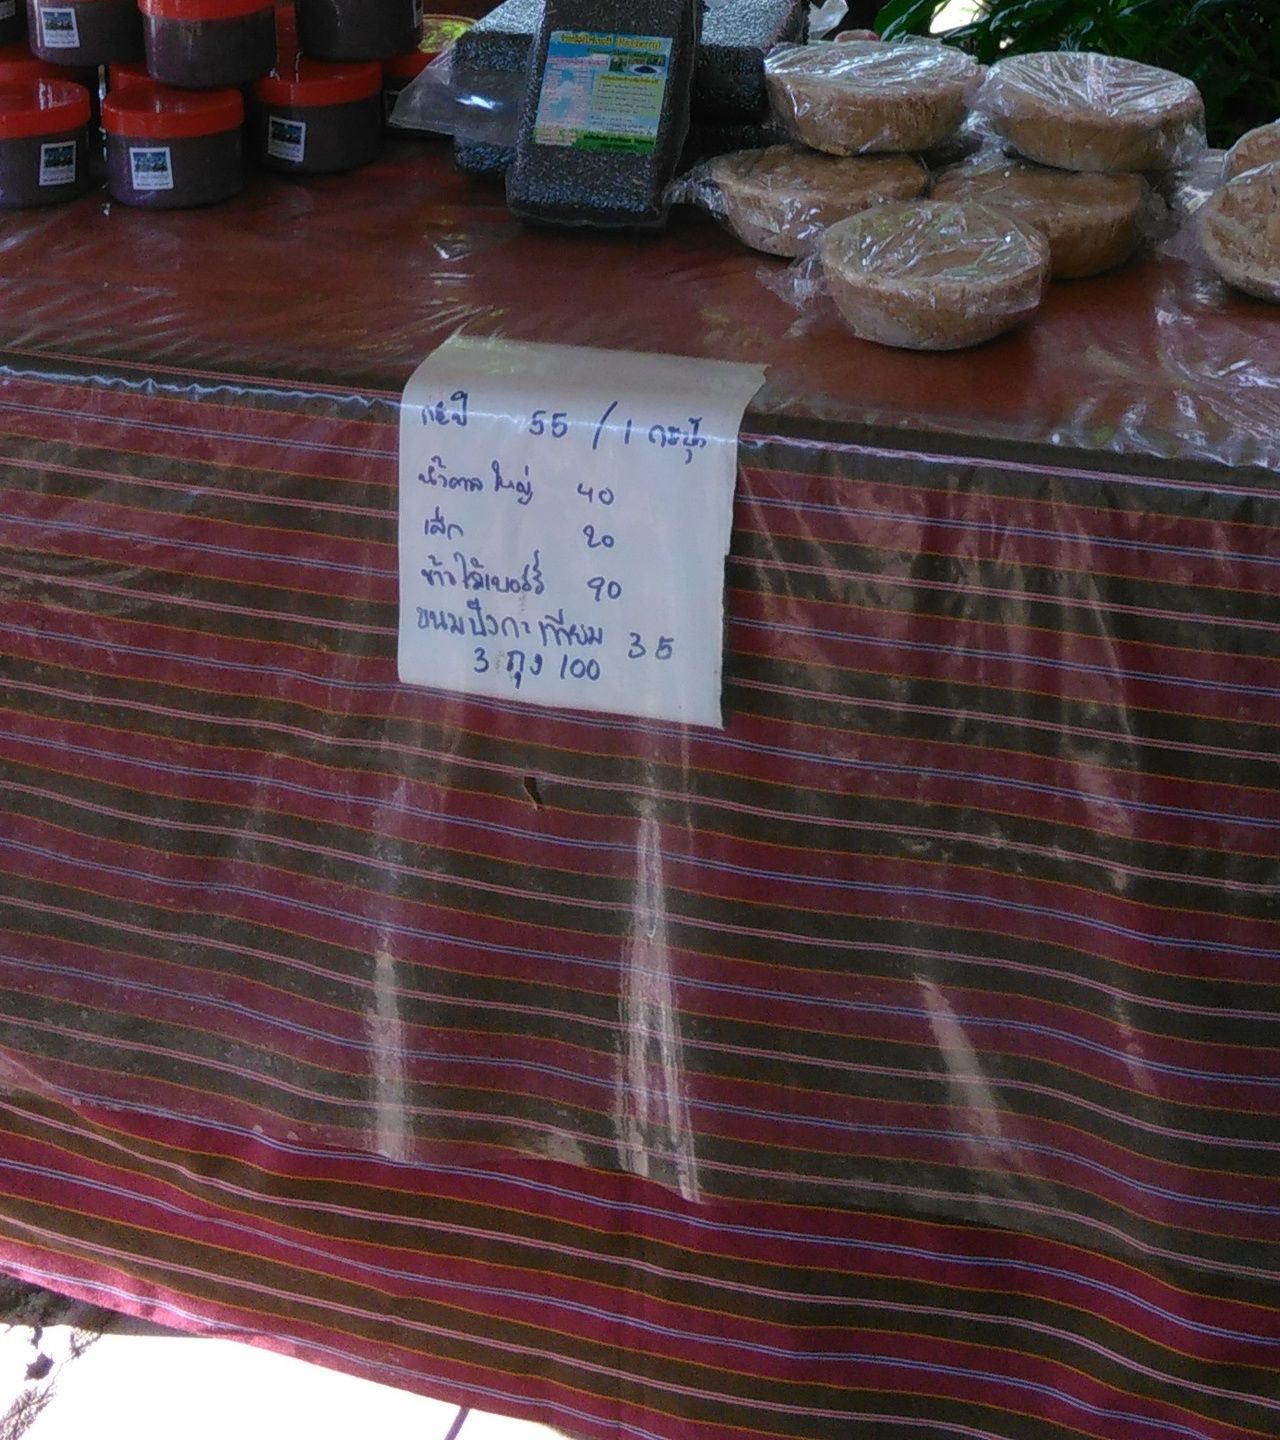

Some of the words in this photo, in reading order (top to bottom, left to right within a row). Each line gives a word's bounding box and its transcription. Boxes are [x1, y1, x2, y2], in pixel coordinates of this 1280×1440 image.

[528, 409, 569, 439] 55
[576, 482, 615, 506] 40
[582, 524, 615, 549] 20
[586, 575, 623, 603] 90
[473, 646, 490, 674] 3
[505, 649, 544, 690] ถุง
[559, 653, 601, 681] 100
